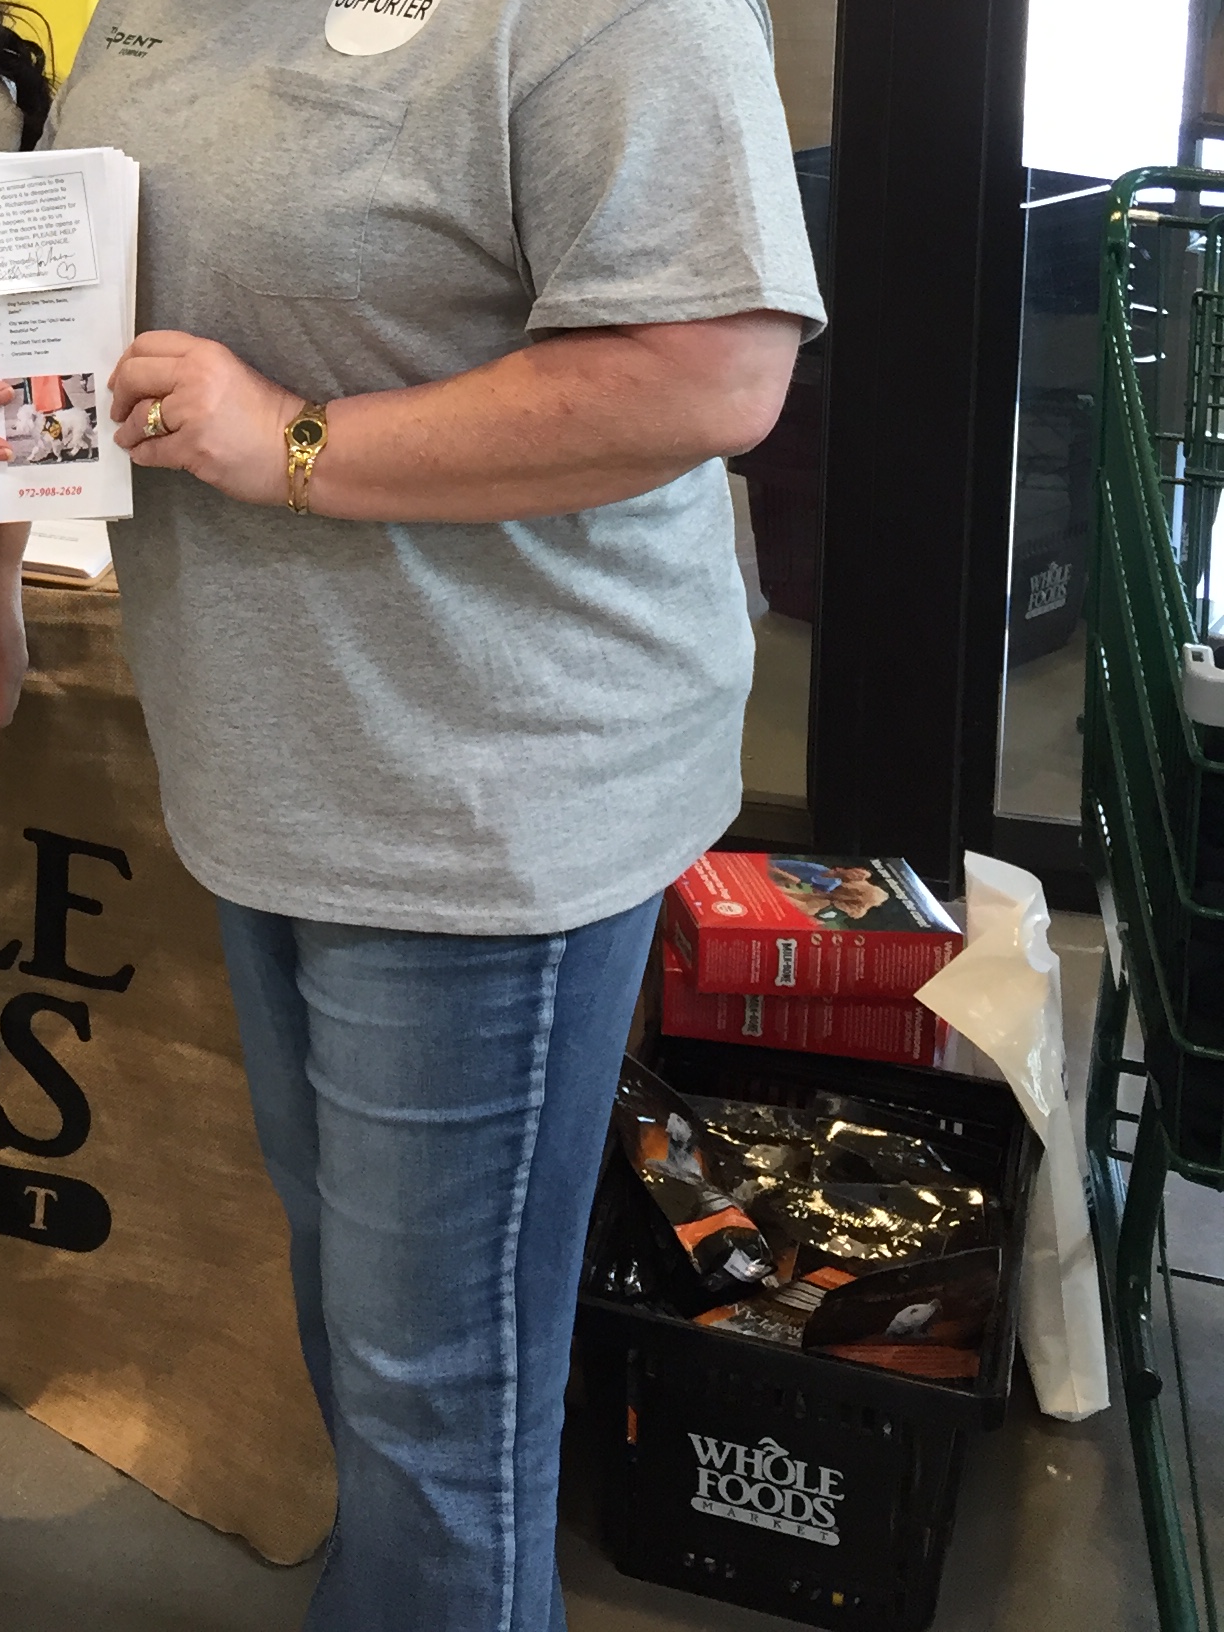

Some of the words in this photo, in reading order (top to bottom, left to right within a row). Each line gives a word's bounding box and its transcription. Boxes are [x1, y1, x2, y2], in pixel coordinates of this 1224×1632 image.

[779, 942, 793, 984] MILK-BONE
[687, 1433, 845, 1501] WHOLE
[695, 1467, 836, 1528] FOODS
[702, 1500, 829, 1542] MARKET
